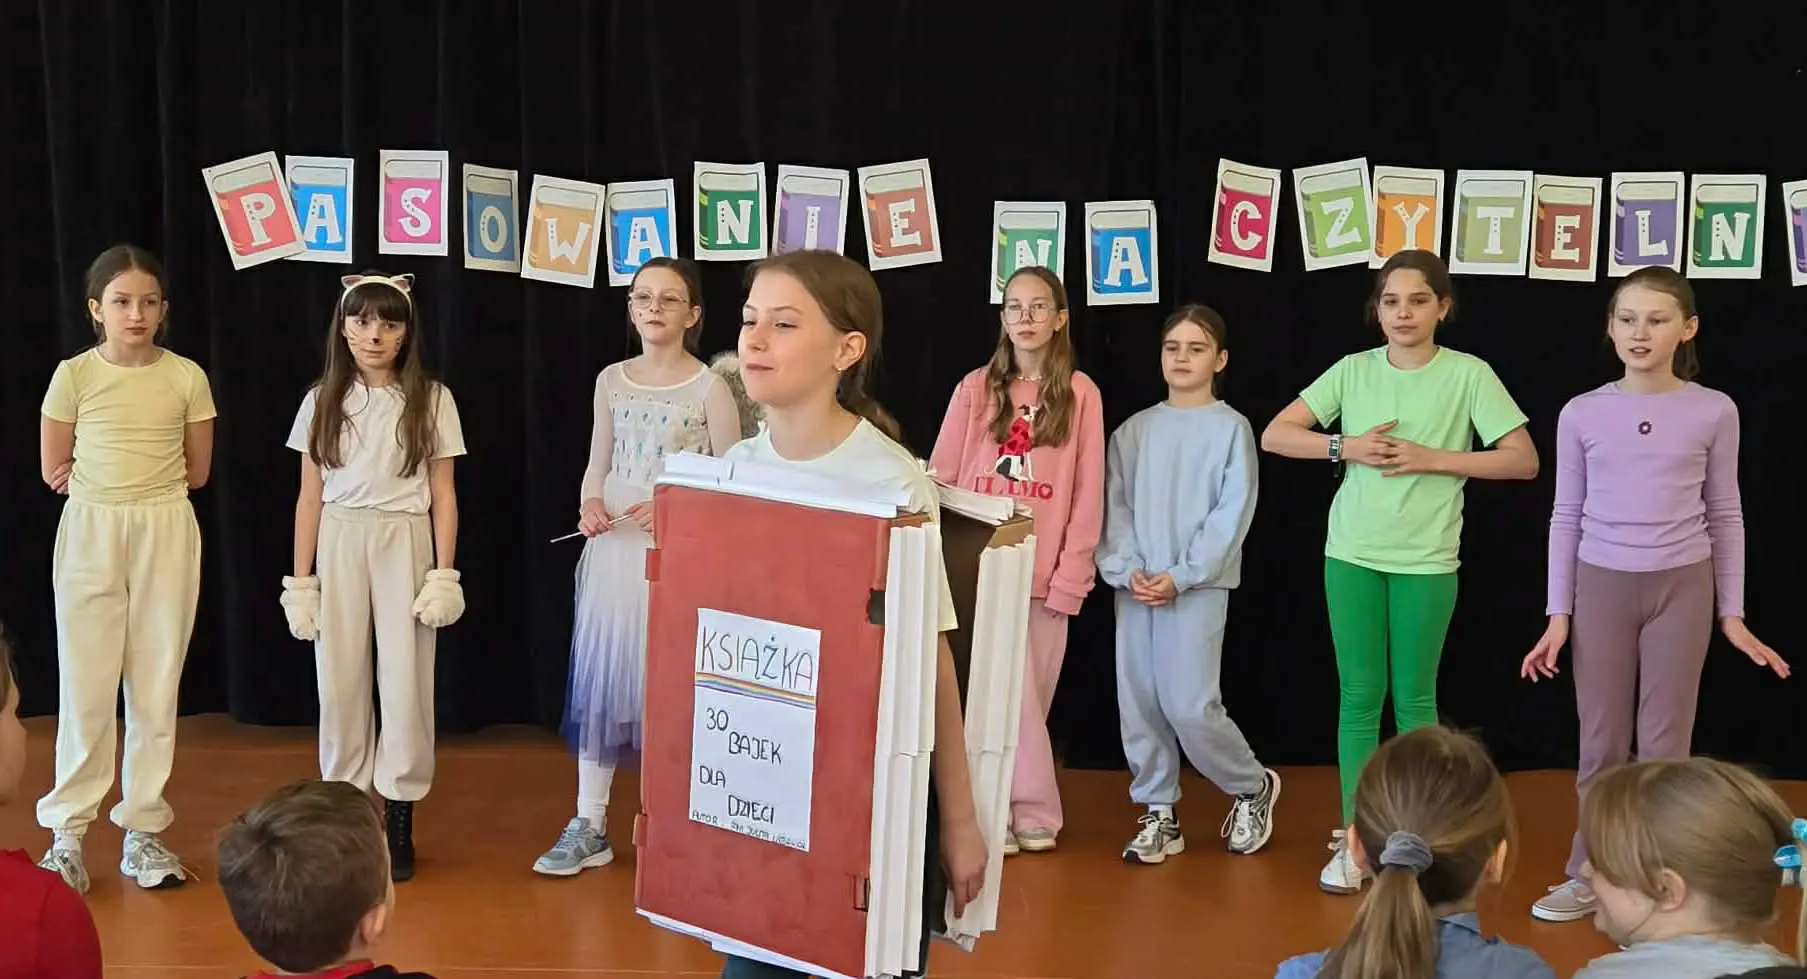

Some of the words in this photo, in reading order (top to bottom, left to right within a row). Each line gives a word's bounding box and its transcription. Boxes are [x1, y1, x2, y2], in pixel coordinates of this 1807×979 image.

[240, 187, 922, 266] PASOWANIE
[1014, 236, 1149, 287] NA
[701, 625, 814, 691] KSIĄŻKA
[706, 707, 729, 731] 30
[729, 731, 782, 765] BAJEK
[699, 765, 726, 789] DLA
[728, 794, 775, 825] DZIECI
